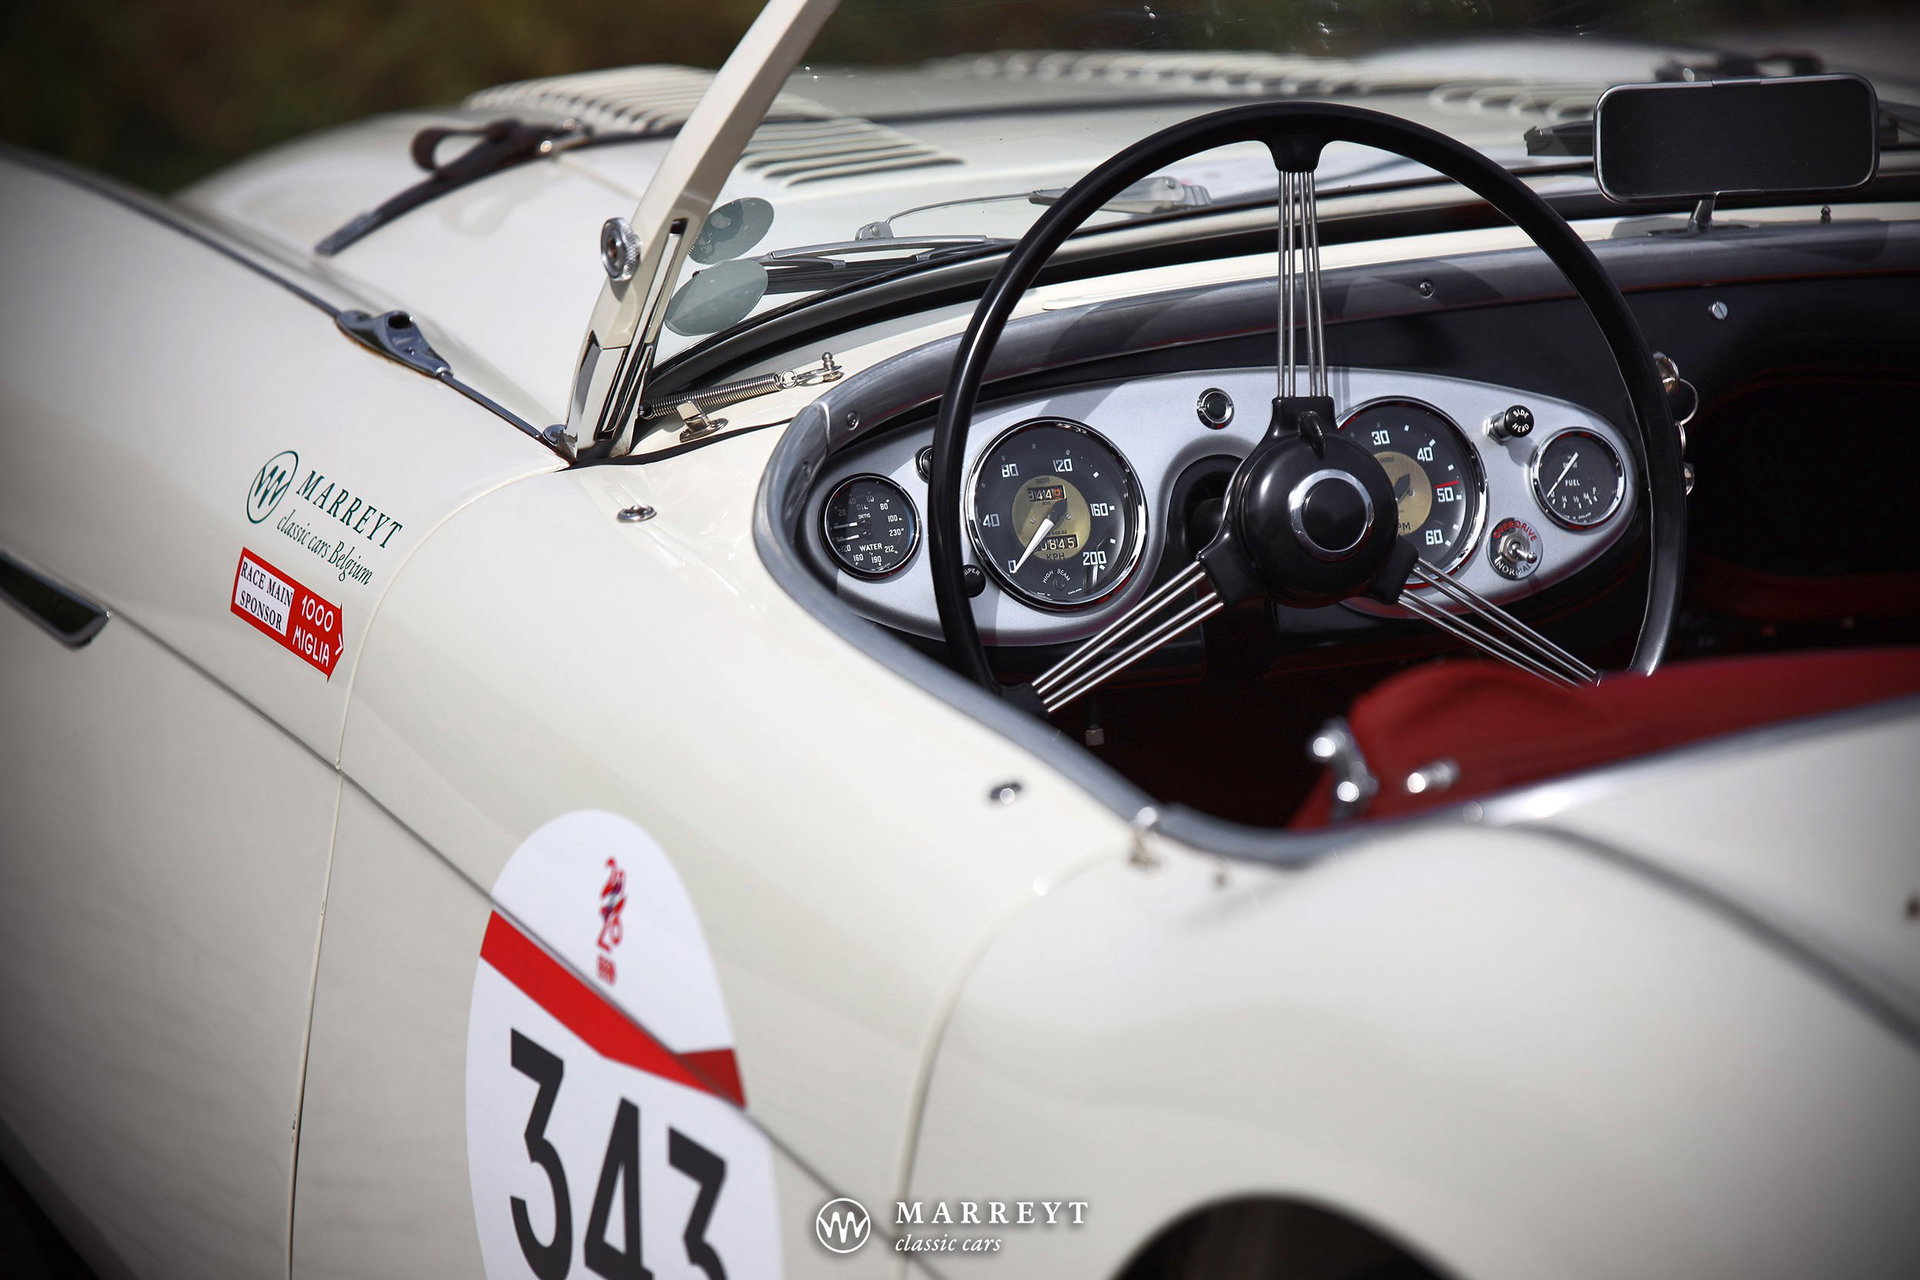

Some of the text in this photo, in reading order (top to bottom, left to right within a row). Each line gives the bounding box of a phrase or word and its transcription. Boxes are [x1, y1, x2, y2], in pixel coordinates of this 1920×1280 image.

[1513, 409, 1529, 418] SIDE
[1512, 422, 1530, 433] HEAD
[1371, 430, 1391, 446] 30
[1417, 447, 1434, 462] 40
[1001, 463, 1019, 478] 80
[1053, 458, 1073, 473] 120
[1437, 486, 1454, 503] 50
[296, 470, 403, 549] MARREYT
[880, 503, 889, 511] 80
[1090, 502, 1109, 517] 160
[982, 513, 1000, 528] 40
[1425, 529, 1444, 545] 60
[1493, 520, 1537, 541] OVERDRIVE
[276, 509, 373, 586] classic cars Belgium
[859, 542, 883, 552] WATER
[1046, 553, 1066, 561] KPH
[1082, 551, 1107, 566] 200
[1007, 560, 1017, 574] 0
[1042, 568, 1071, 584] HIGH BEAM
[240, 561, 294, 607] RACE MAIN
[240, 590, 282, 631] SPONSOR
[301, 595, 334, 632] 1000
[292, 625, 330, 667] MIGLIA
[509, 1027, 729, 1280] 343
